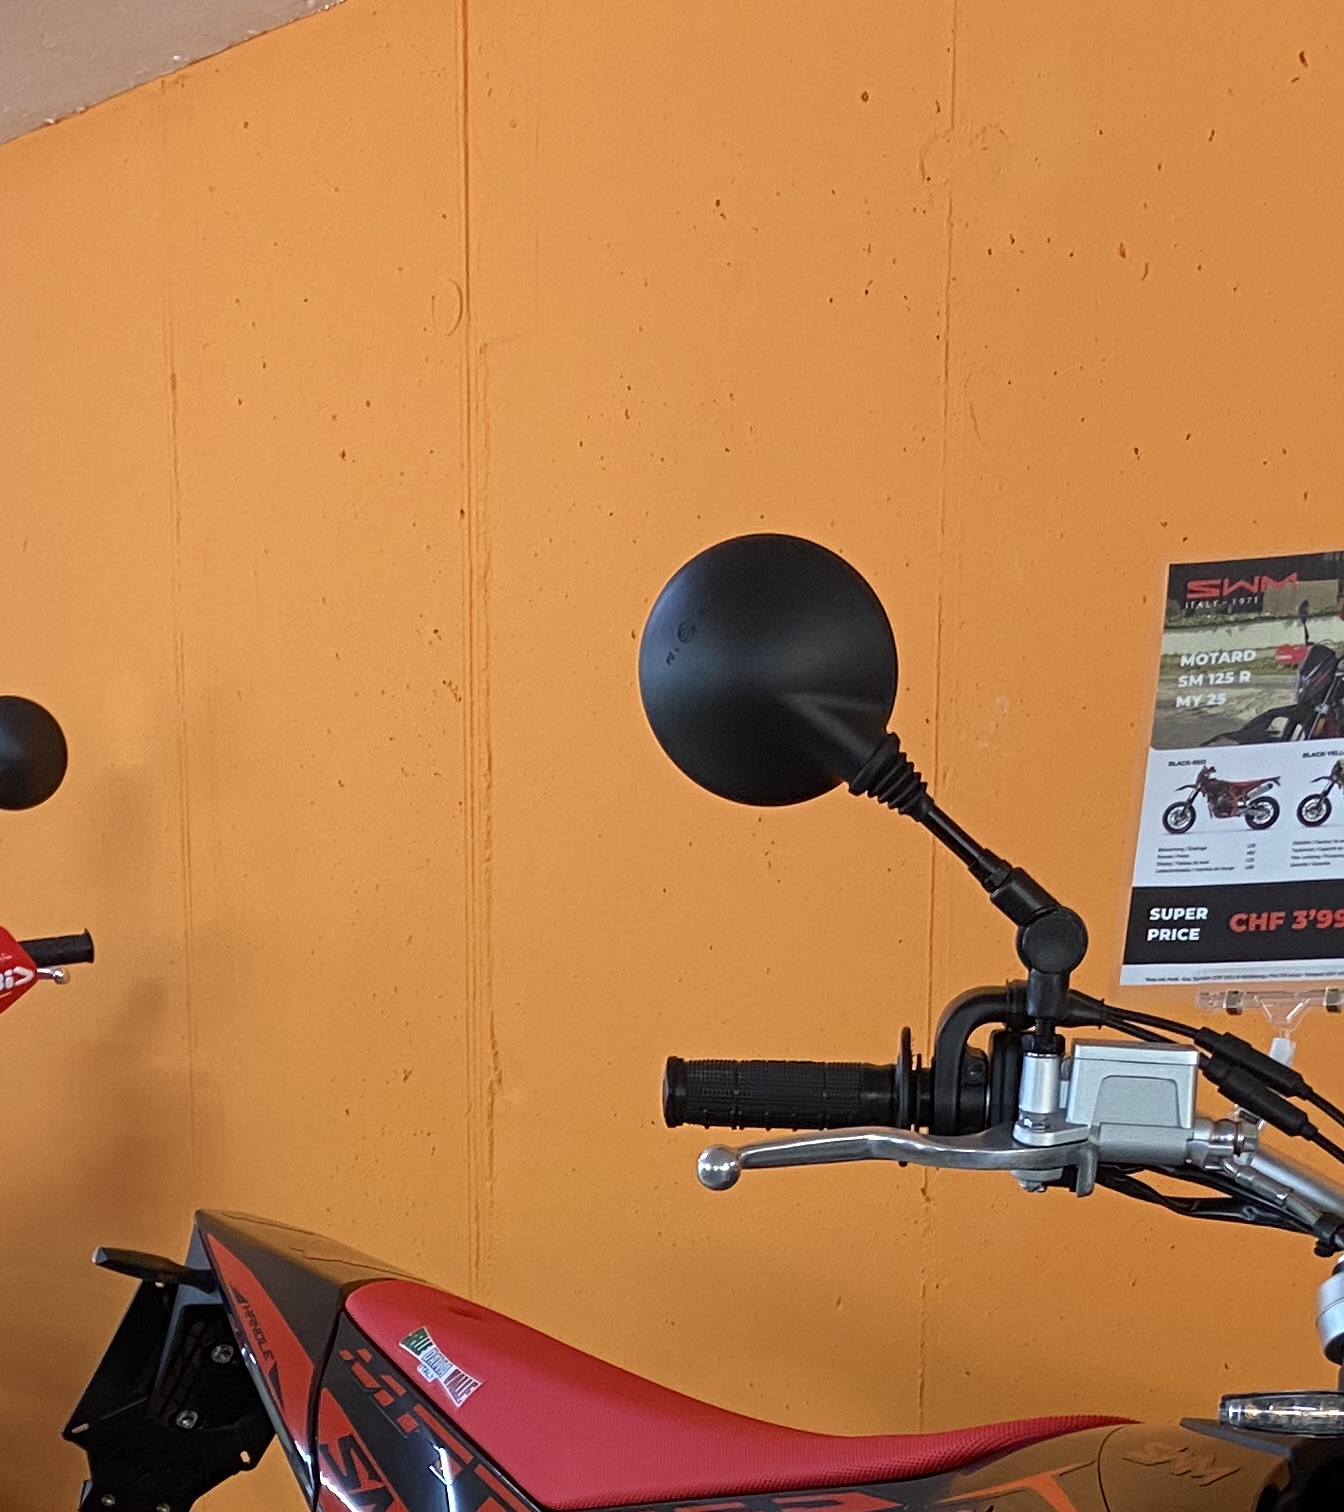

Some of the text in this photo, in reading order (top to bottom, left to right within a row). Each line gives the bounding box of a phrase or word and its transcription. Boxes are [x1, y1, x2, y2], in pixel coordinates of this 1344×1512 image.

[1186, 572, 1299, 599] SWM
[1185, 600, 1219, 609] ITALY
[1232, 596, 1259, 605] 1971
[1180, 649, 1257, 667] MOTARD
[1177, 670, 1251, 688] SM 125 R
[1175, 692, 1227, 708] MY 25
[1149, 907, 1208, 921] SUPER
[1228, 911, 1286, 933] CHF
[1146, 927, 1201, 941] PRICE
